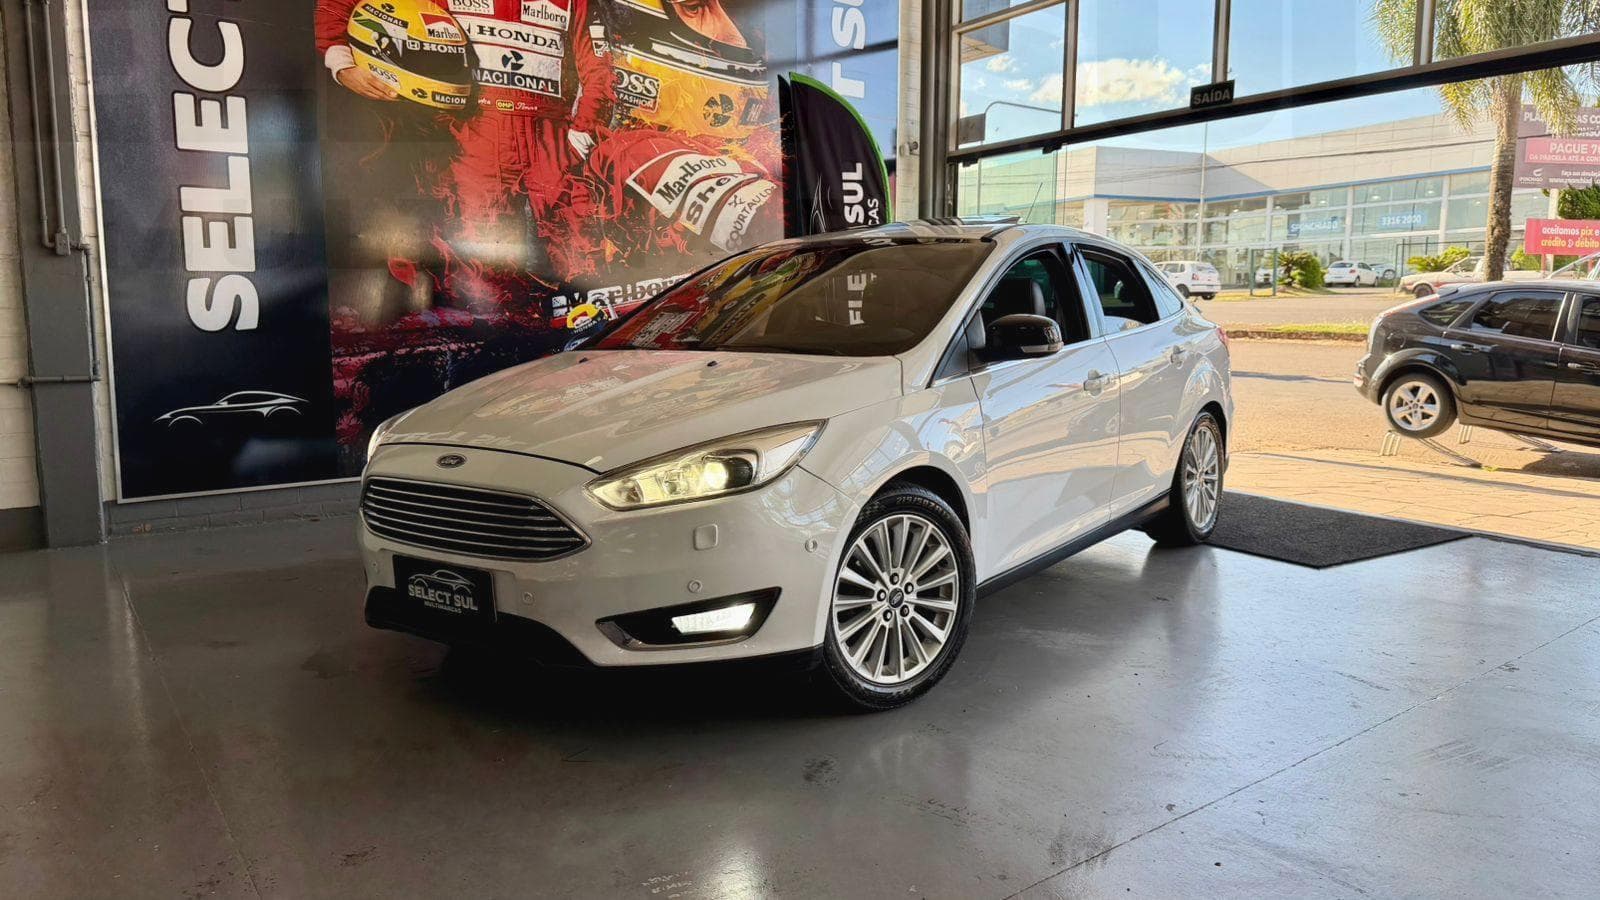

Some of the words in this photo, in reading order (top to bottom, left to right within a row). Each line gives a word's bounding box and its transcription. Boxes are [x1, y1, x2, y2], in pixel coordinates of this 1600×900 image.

[365, 5, 404, 26] NACIONAL
[522, 4, 567, 24] Marlboro
[477, 25, 561, 50] HONDA
[423, 42, 466, 54] HOND
[616, 70, 659, 97] OSS
[435, 93, 466, 104] NACION
[619, 93, 653, 108] FASHION
[1193, 88, 1231, 105] SAÍDA
[1549, 142, 1588, 154] PAGUE
[167, 0, 259, 331] SELEC
[656, 158, 727, 205] Marlboro
[842, 162, 865, 224] SUL
[1542, 224, 1579, 235] aceitamos
[1581, 226, 1594, 238] pix
[1541, 237, 1567, 247] crédito
[1575, 237, 1600, 248] débito
[408, 584, 451, 604] SELECT
[454, 595, 478, 611] SUL
